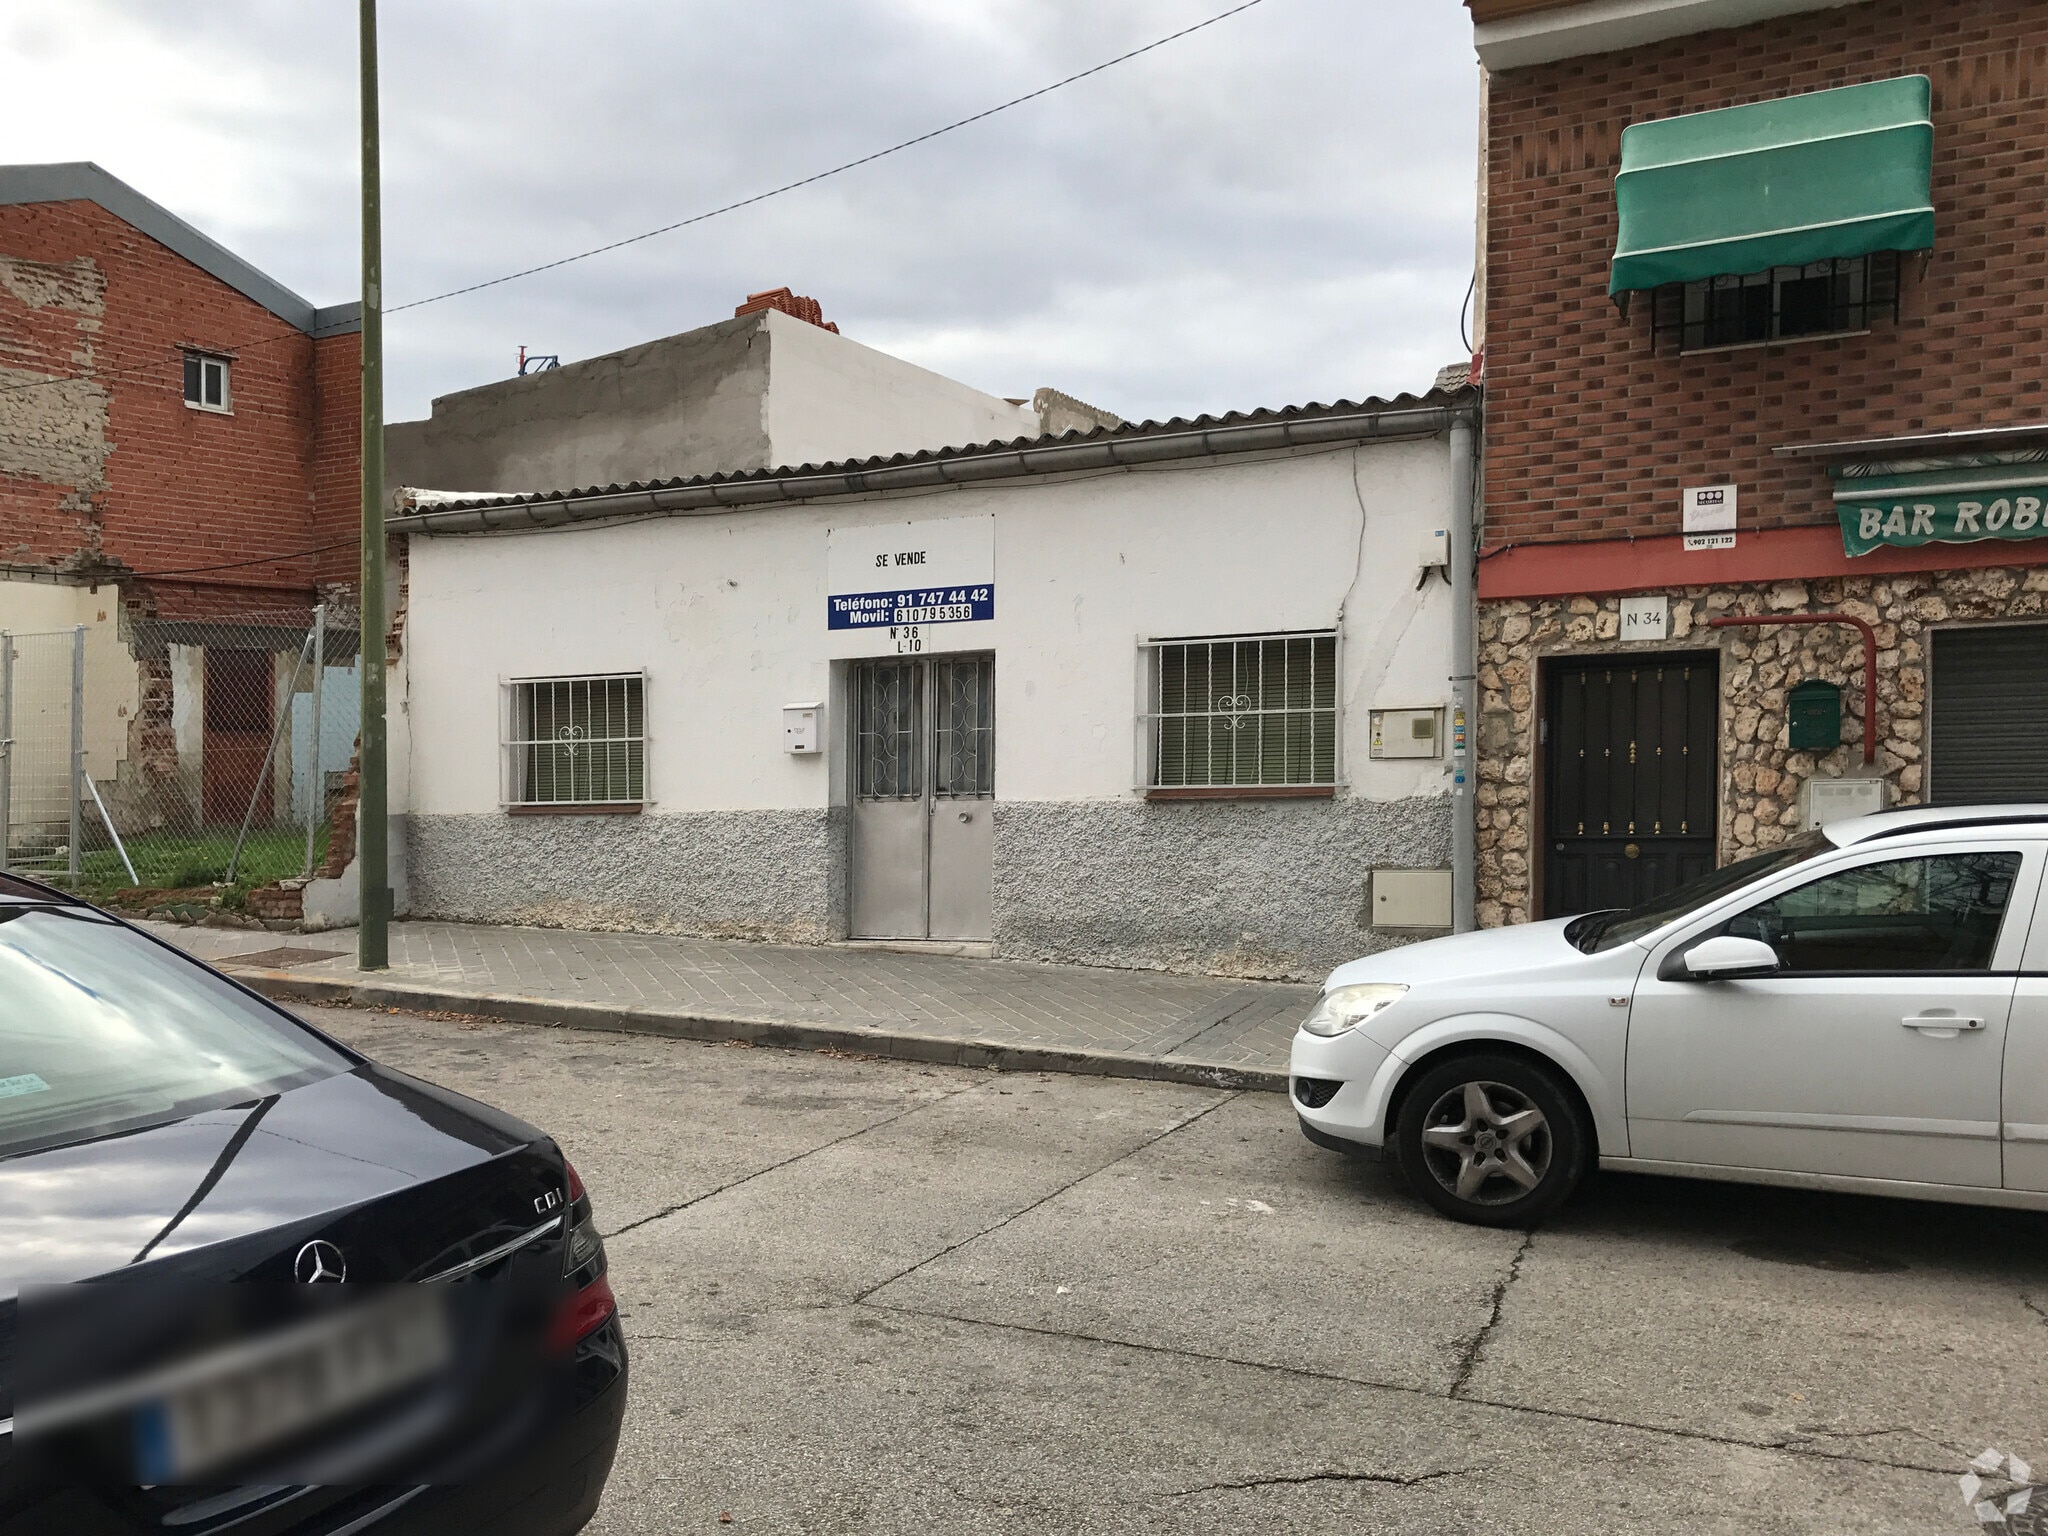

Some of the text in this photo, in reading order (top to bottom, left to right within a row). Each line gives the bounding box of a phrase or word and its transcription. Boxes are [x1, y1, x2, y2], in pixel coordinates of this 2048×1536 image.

[1858, 504, 1936, 540] BAR
[1693, 536, 1733, 546] 902 121 122
[875, 551, 927, 567] SE VENDE
[833, 588, 988, 611] Teléfono: 91 747 44 42
[849, 606, 971, 624] Movil: 610795356
[1643, 612, 1662, 624] 34
[903, 626, 919, 639] 36
[533, 1187, 563, 1215] CDI
